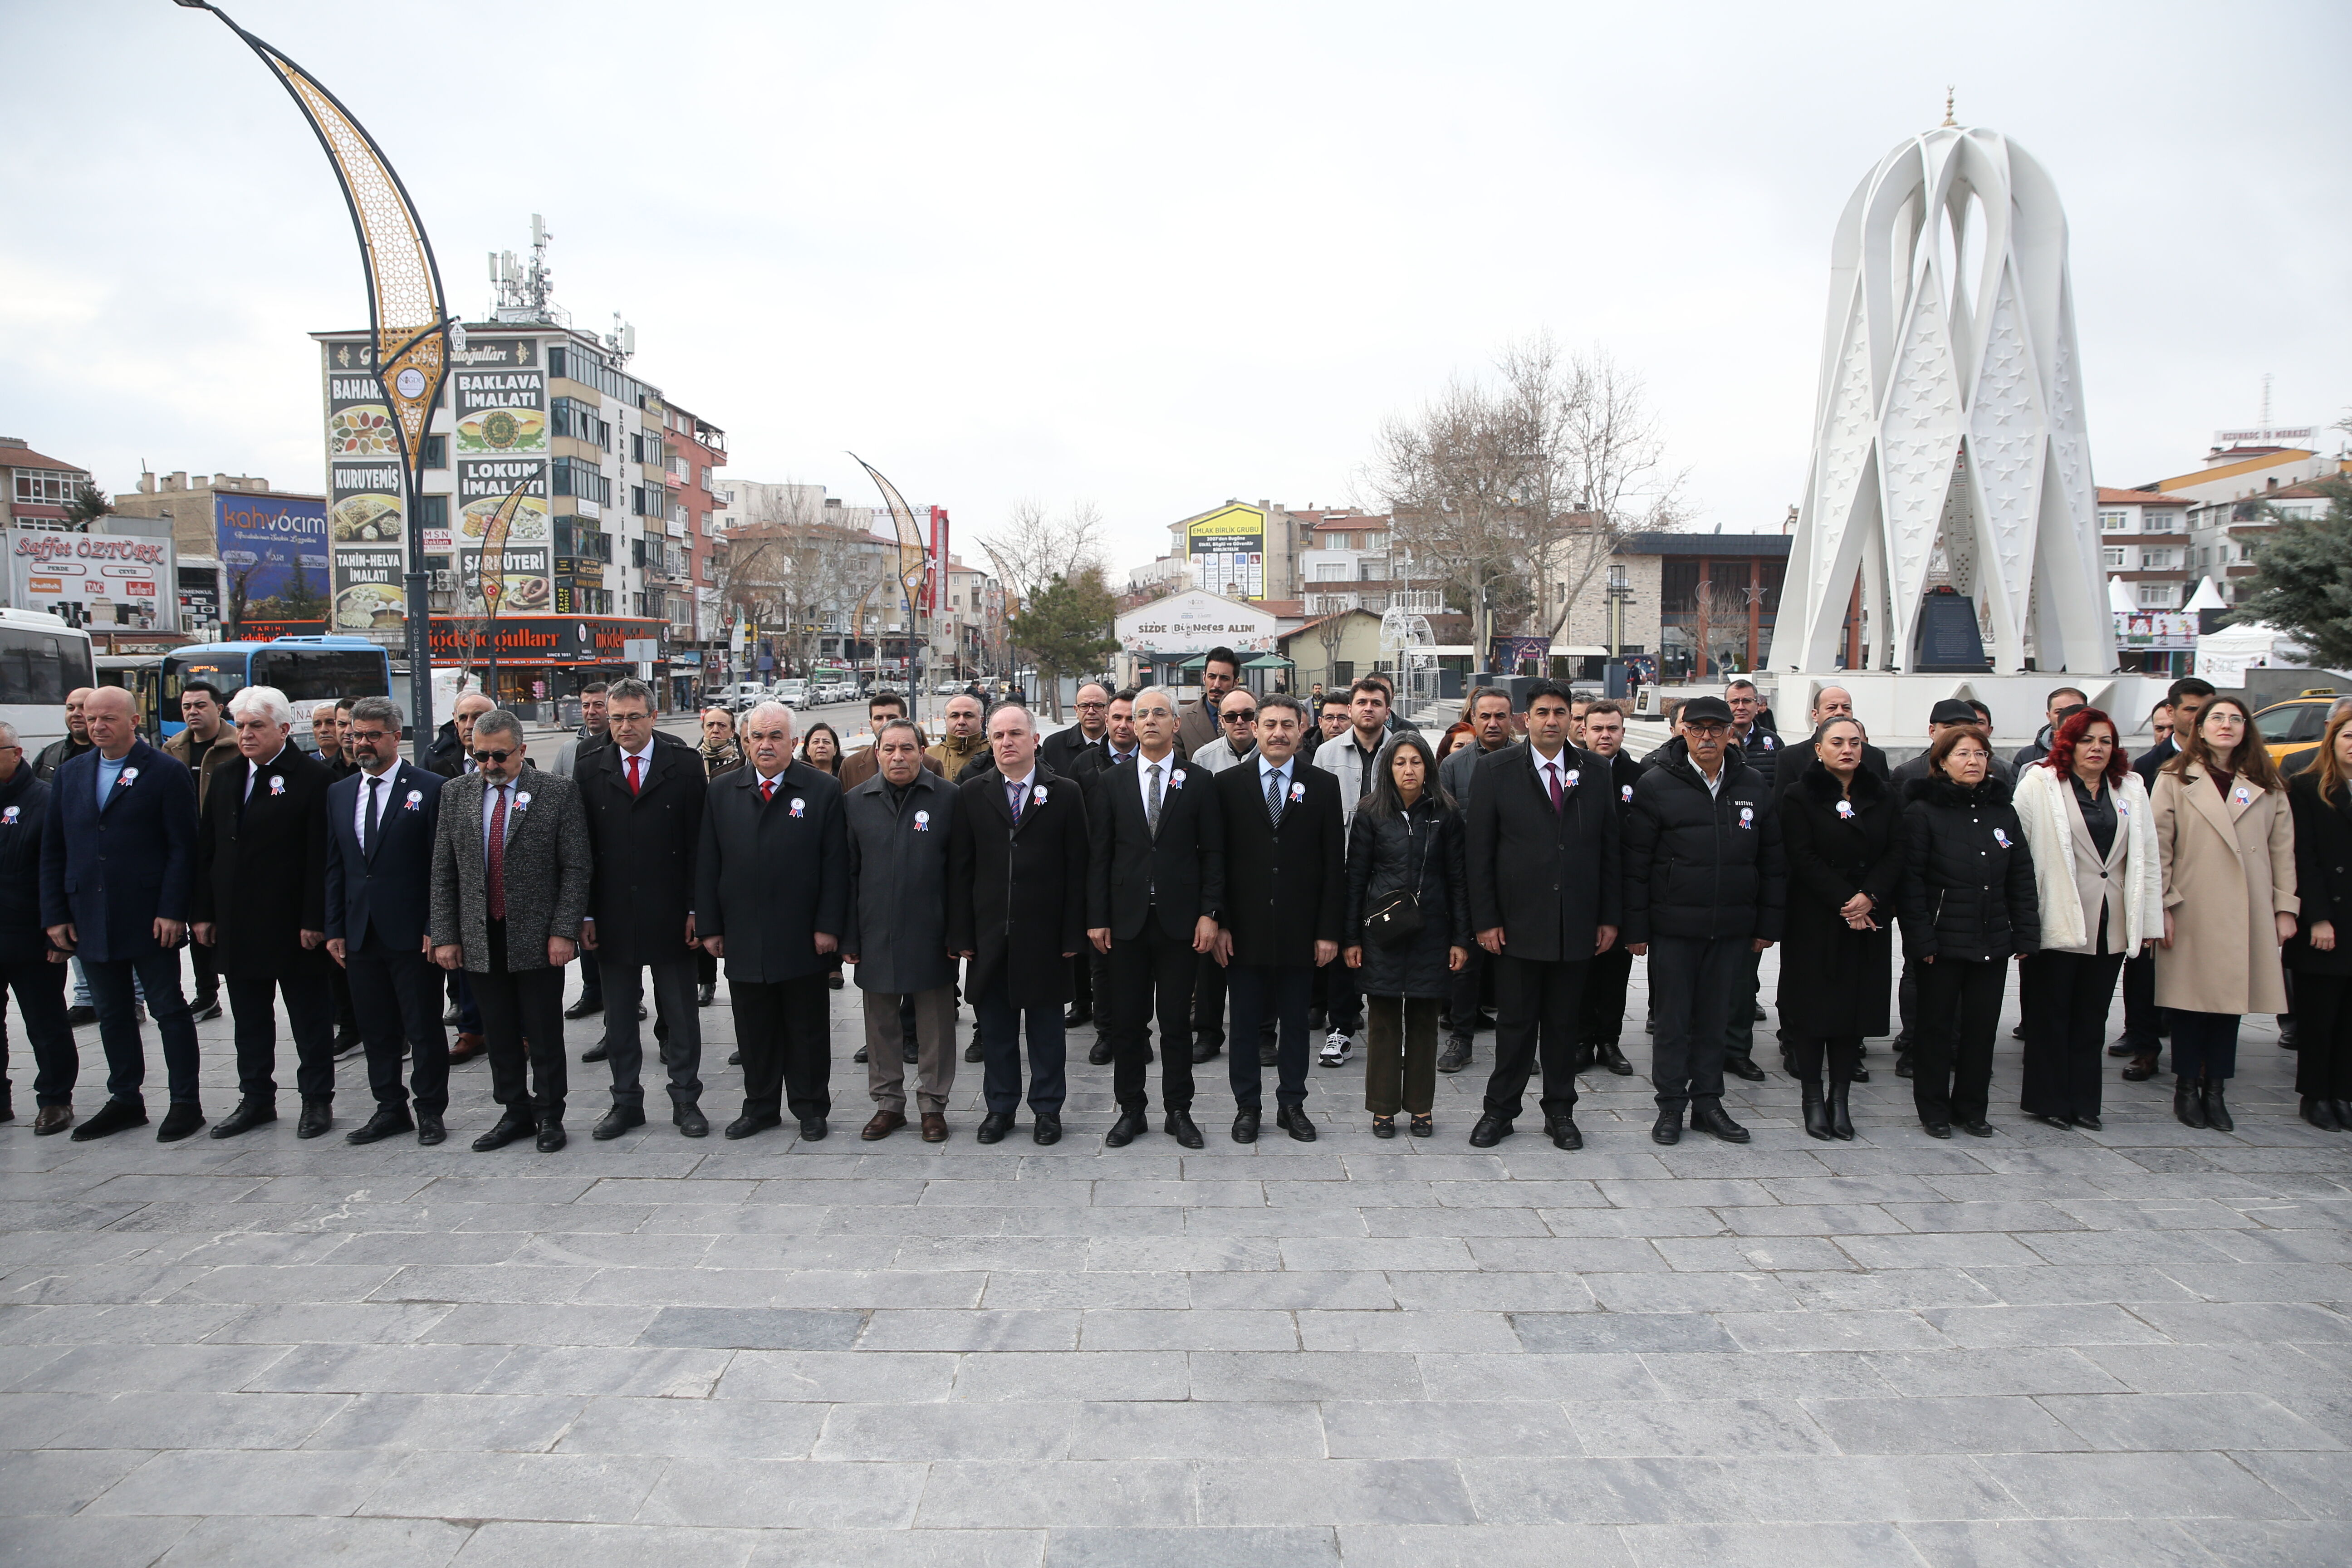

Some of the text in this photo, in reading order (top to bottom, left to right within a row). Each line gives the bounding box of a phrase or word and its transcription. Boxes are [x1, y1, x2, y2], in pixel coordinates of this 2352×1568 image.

[333, 379, 393, 400] BAHAR
[459, 374, 541, 391] BAKLAVA
[465, 392, 536, 407] İMALATI
[335, 465, 399, 492] KURUYEMİŞ
[468, 463, 538, 478] LOKUM
[15, 537, 164, 564] Saffet ÖZTÜRK
[336, 552, 400, 567] TAHİN-HELVA
[350, 568, 388, 582] İMALATI
